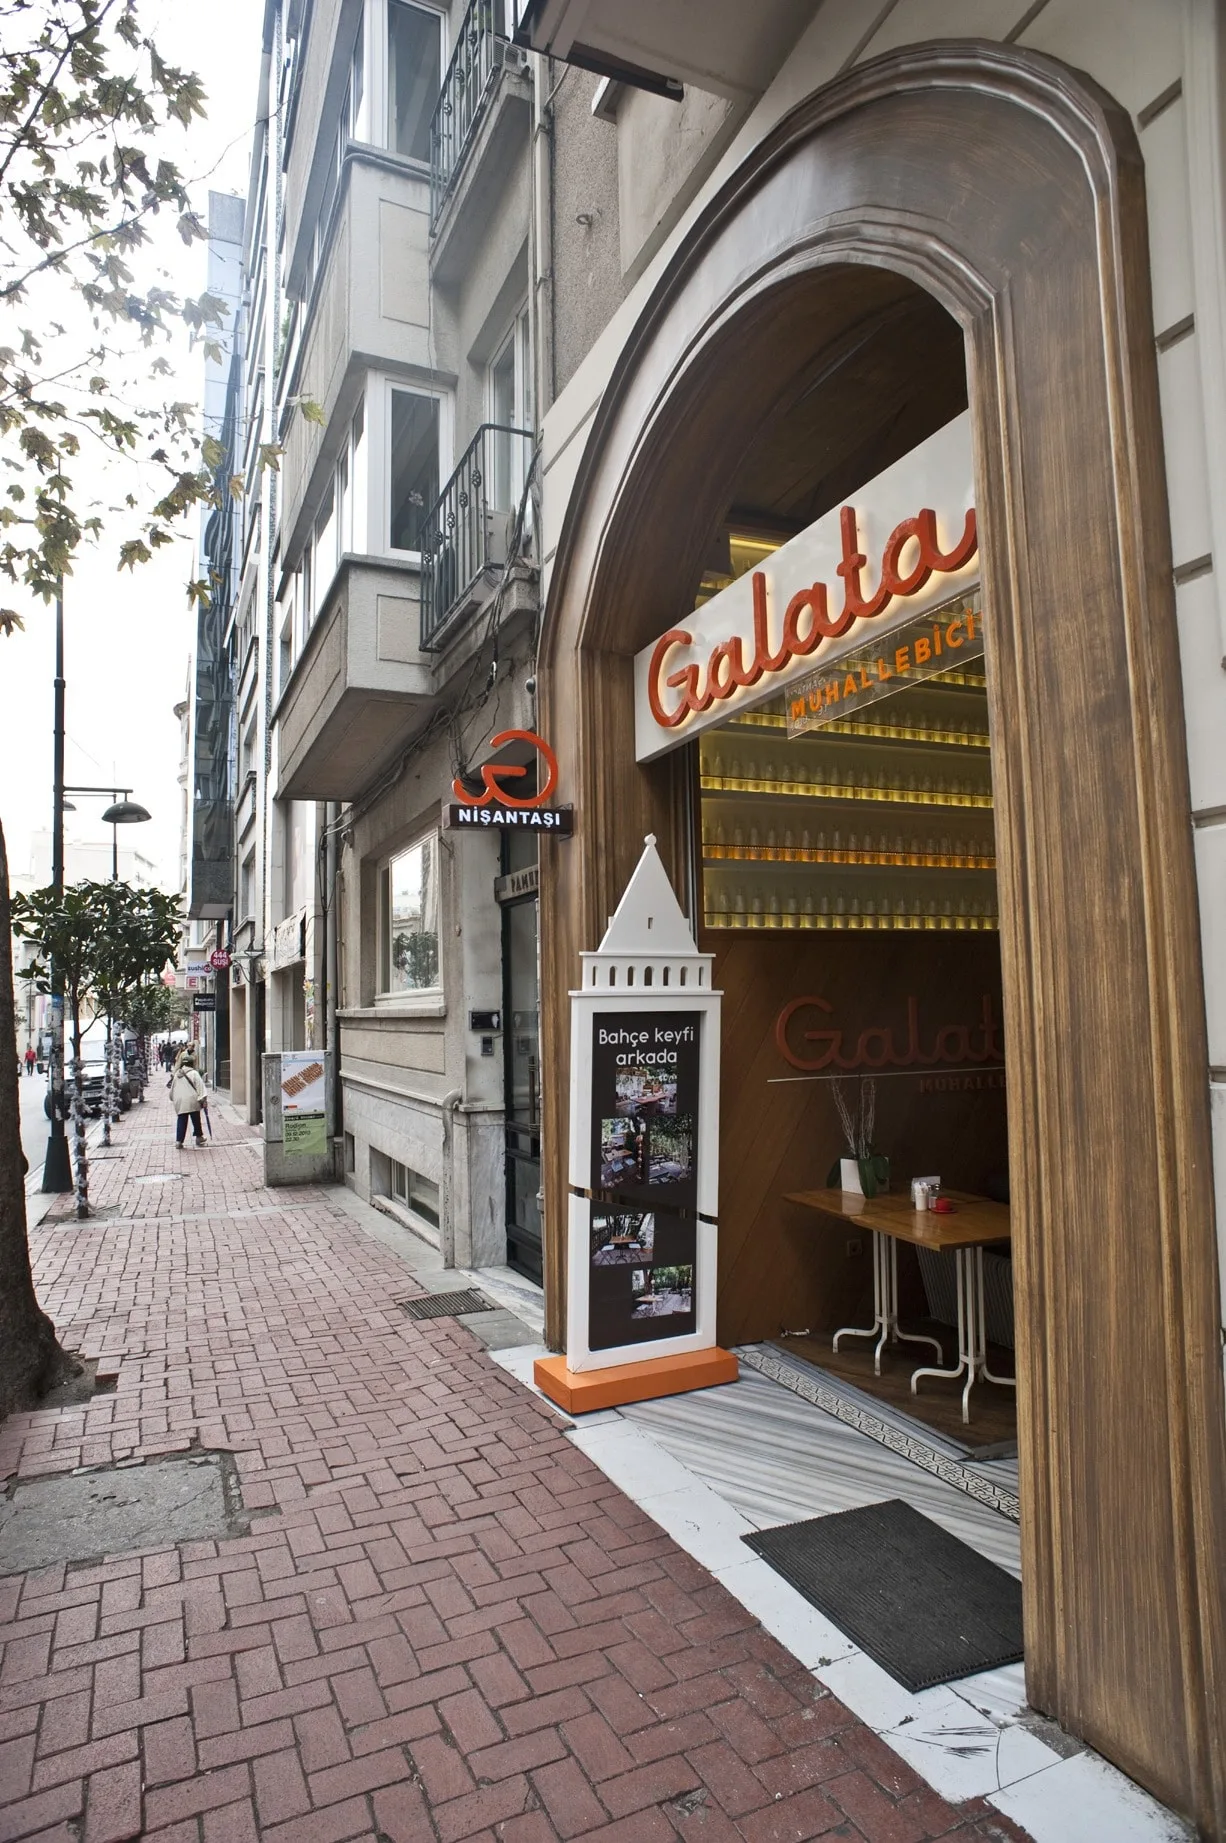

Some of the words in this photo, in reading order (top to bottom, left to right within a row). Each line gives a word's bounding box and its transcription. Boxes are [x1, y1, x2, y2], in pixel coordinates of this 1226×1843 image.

[648, 505, 978, 728] Galata
[791, 608, 984, 720] MUHALLEBİCİ
[459, 806, 561, 828] NİŞANTAŞI
[599, 1028, 649, 1047] Bahçe
[655, 1026, 694, 1045] keyfi
[616, 1048, 678, 1065] arkada
[776, 995, 1006, 1071] Galat
